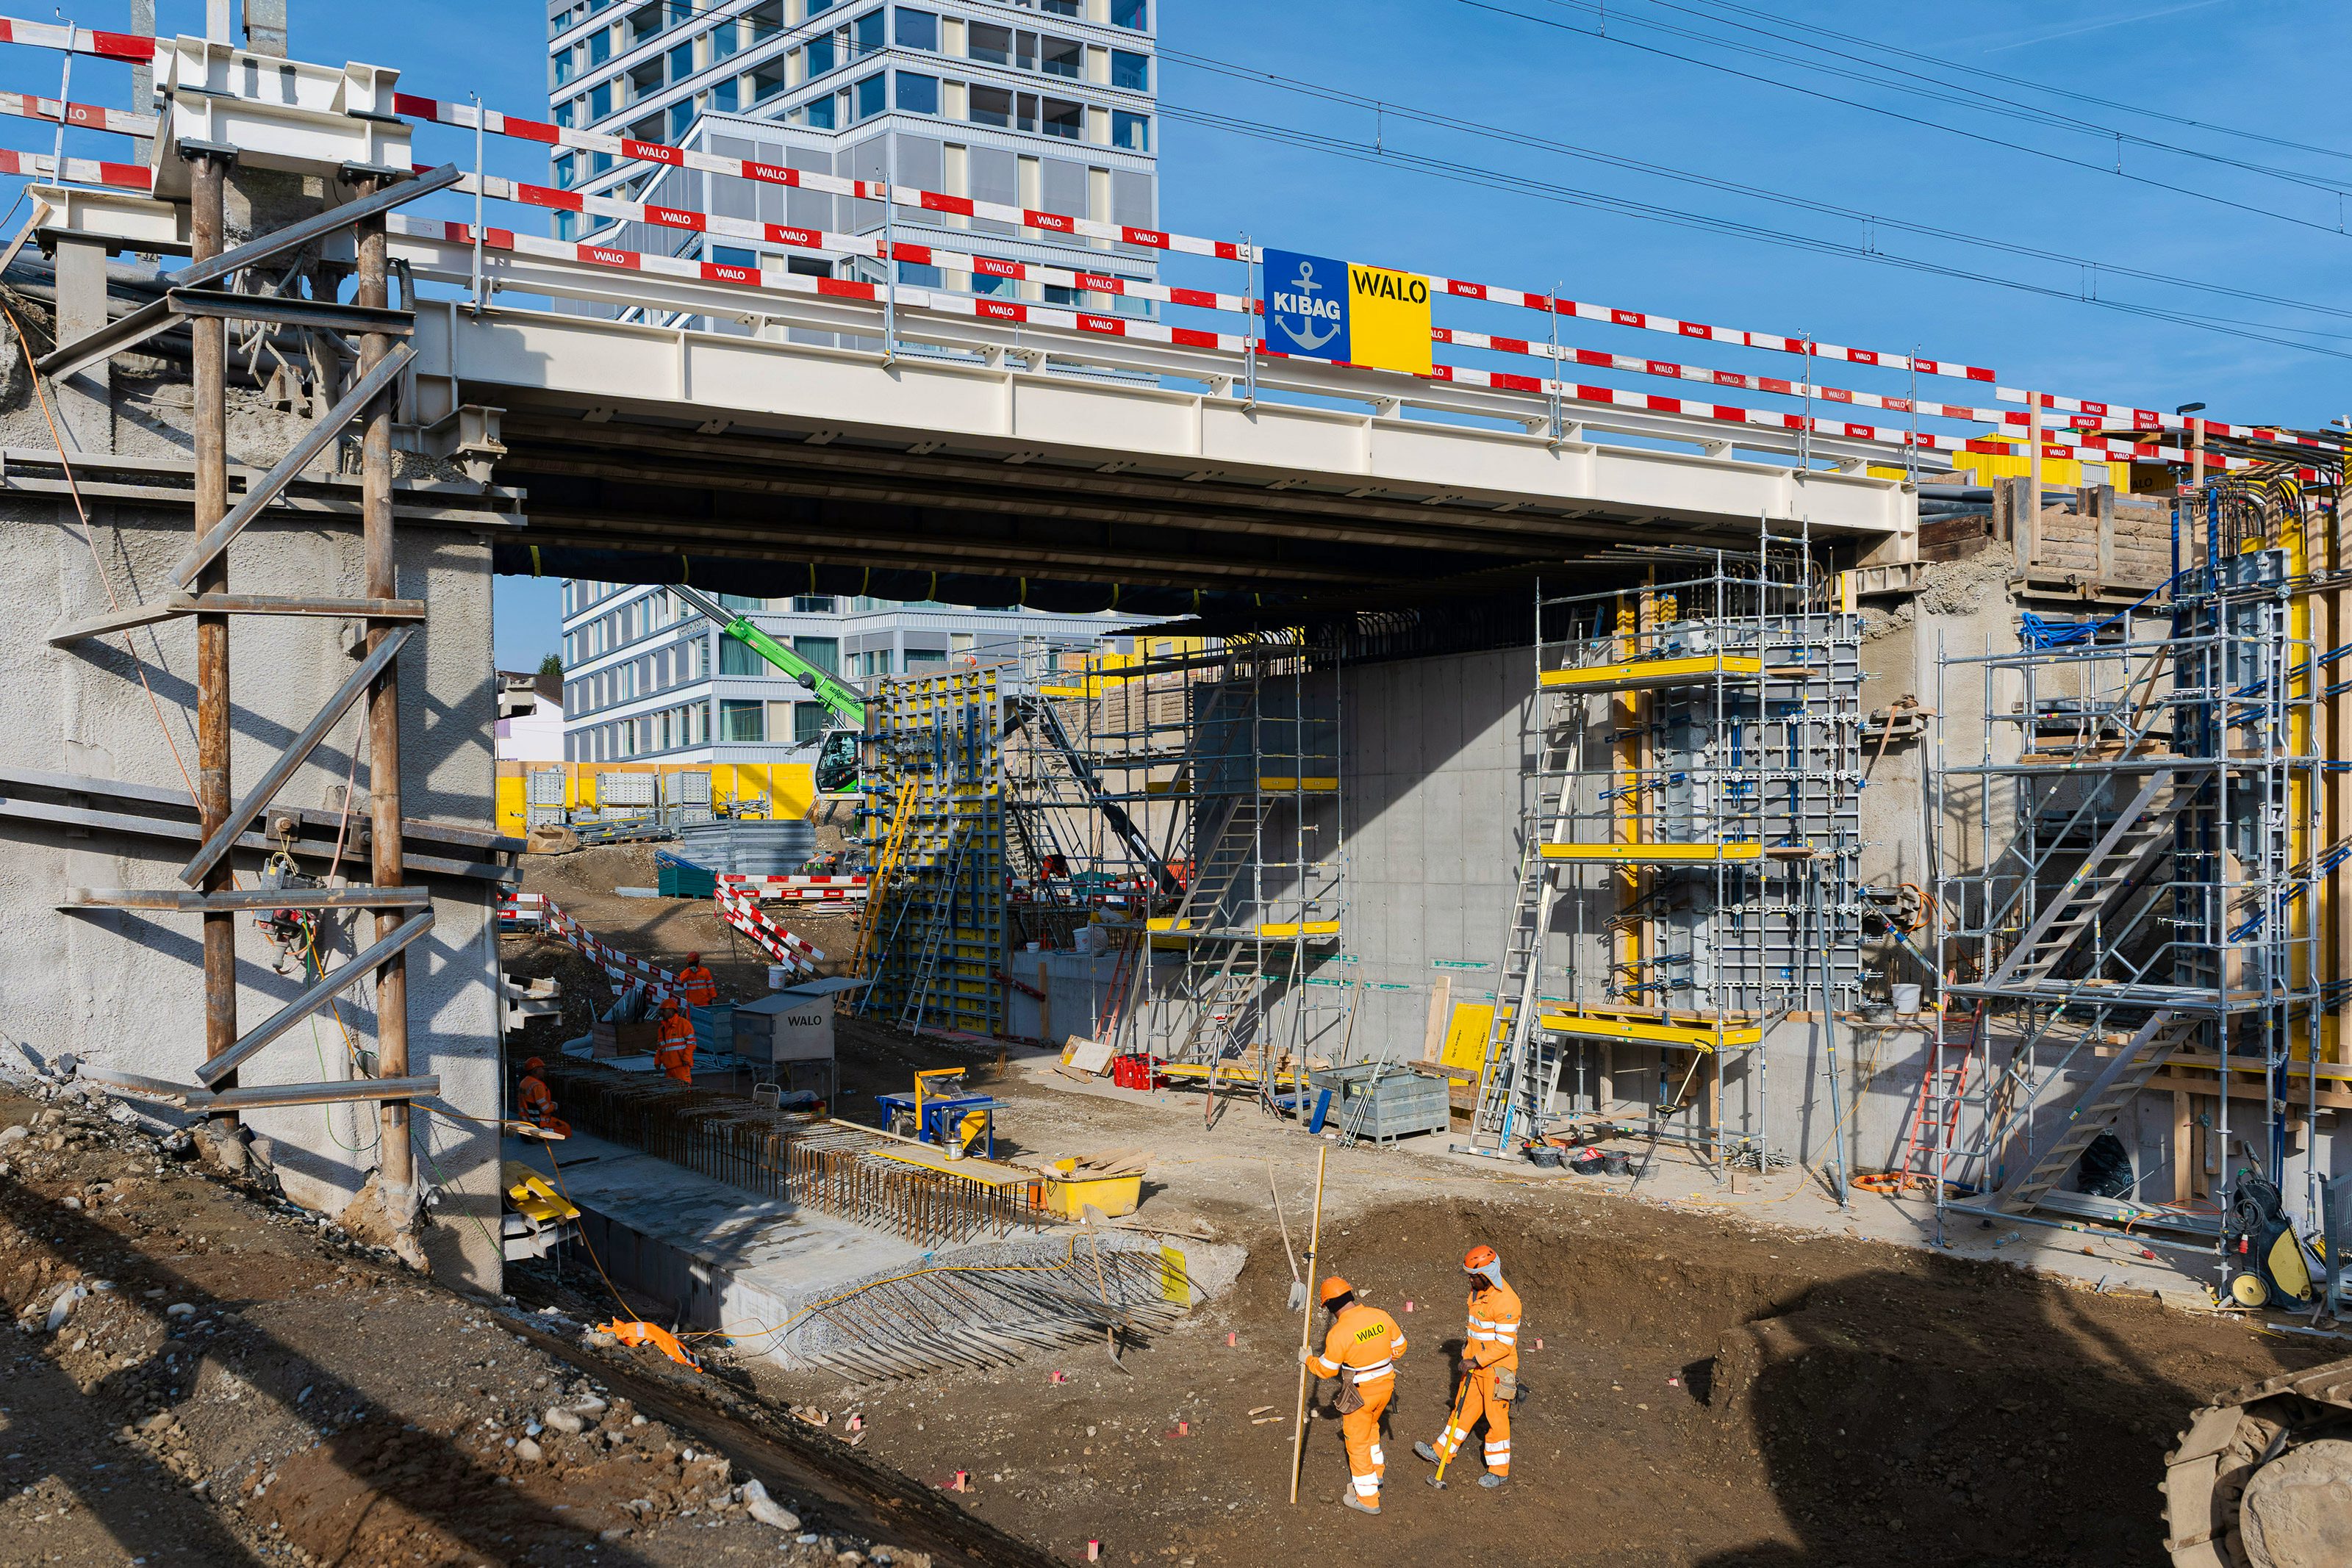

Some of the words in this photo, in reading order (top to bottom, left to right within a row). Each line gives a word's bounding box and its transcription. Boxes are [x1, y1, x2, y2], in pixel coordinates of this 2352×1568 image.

[637, 145, 669, 159] WALO
[756, 167, 786, 180] WALO
[661, 212, 691, 224] WALO
[1037, 216, 1061, 226] WALO
[779, 230, 807, 242] WALO
[1134, 232, 1158, 242] WALO
[594, 251, 624, 263] WALO
[986, 262, 1013, 274] WALO
[716, 268, 745, 279] WALO
[1086, 278, 1112, 289] WALO
[1352, 270, 1427, 303] WALO
[1458, 285, 1477, 295] WALO
[989, 305, 1014, 316] WALO
[1274, 292, 1340, 320] KIBAG
[1620, 314, 1637, 323] WALO
[1089, 320, 1113, 330] WALO
[1687, 326, 1703, 334] WALO
[1431, 330, 1444, 339] ALO
[1855, 353, 1871, 361] WALO
[1654, 364, 1673, 373] WALO
[1721, 375, 1738, 384] WALO
[1828, 391, 1845, 399] WALO
[1888, 400, 1905, 408] WALO
[2087, 404, 2101, 412] WALO
[2139, 412, 2154, 420] WALO
[2114, 453, 2129, 461] WALO
[788, 1015, 822, 1026] WALO
[1356, 1324, 1384, 1342] WALO
